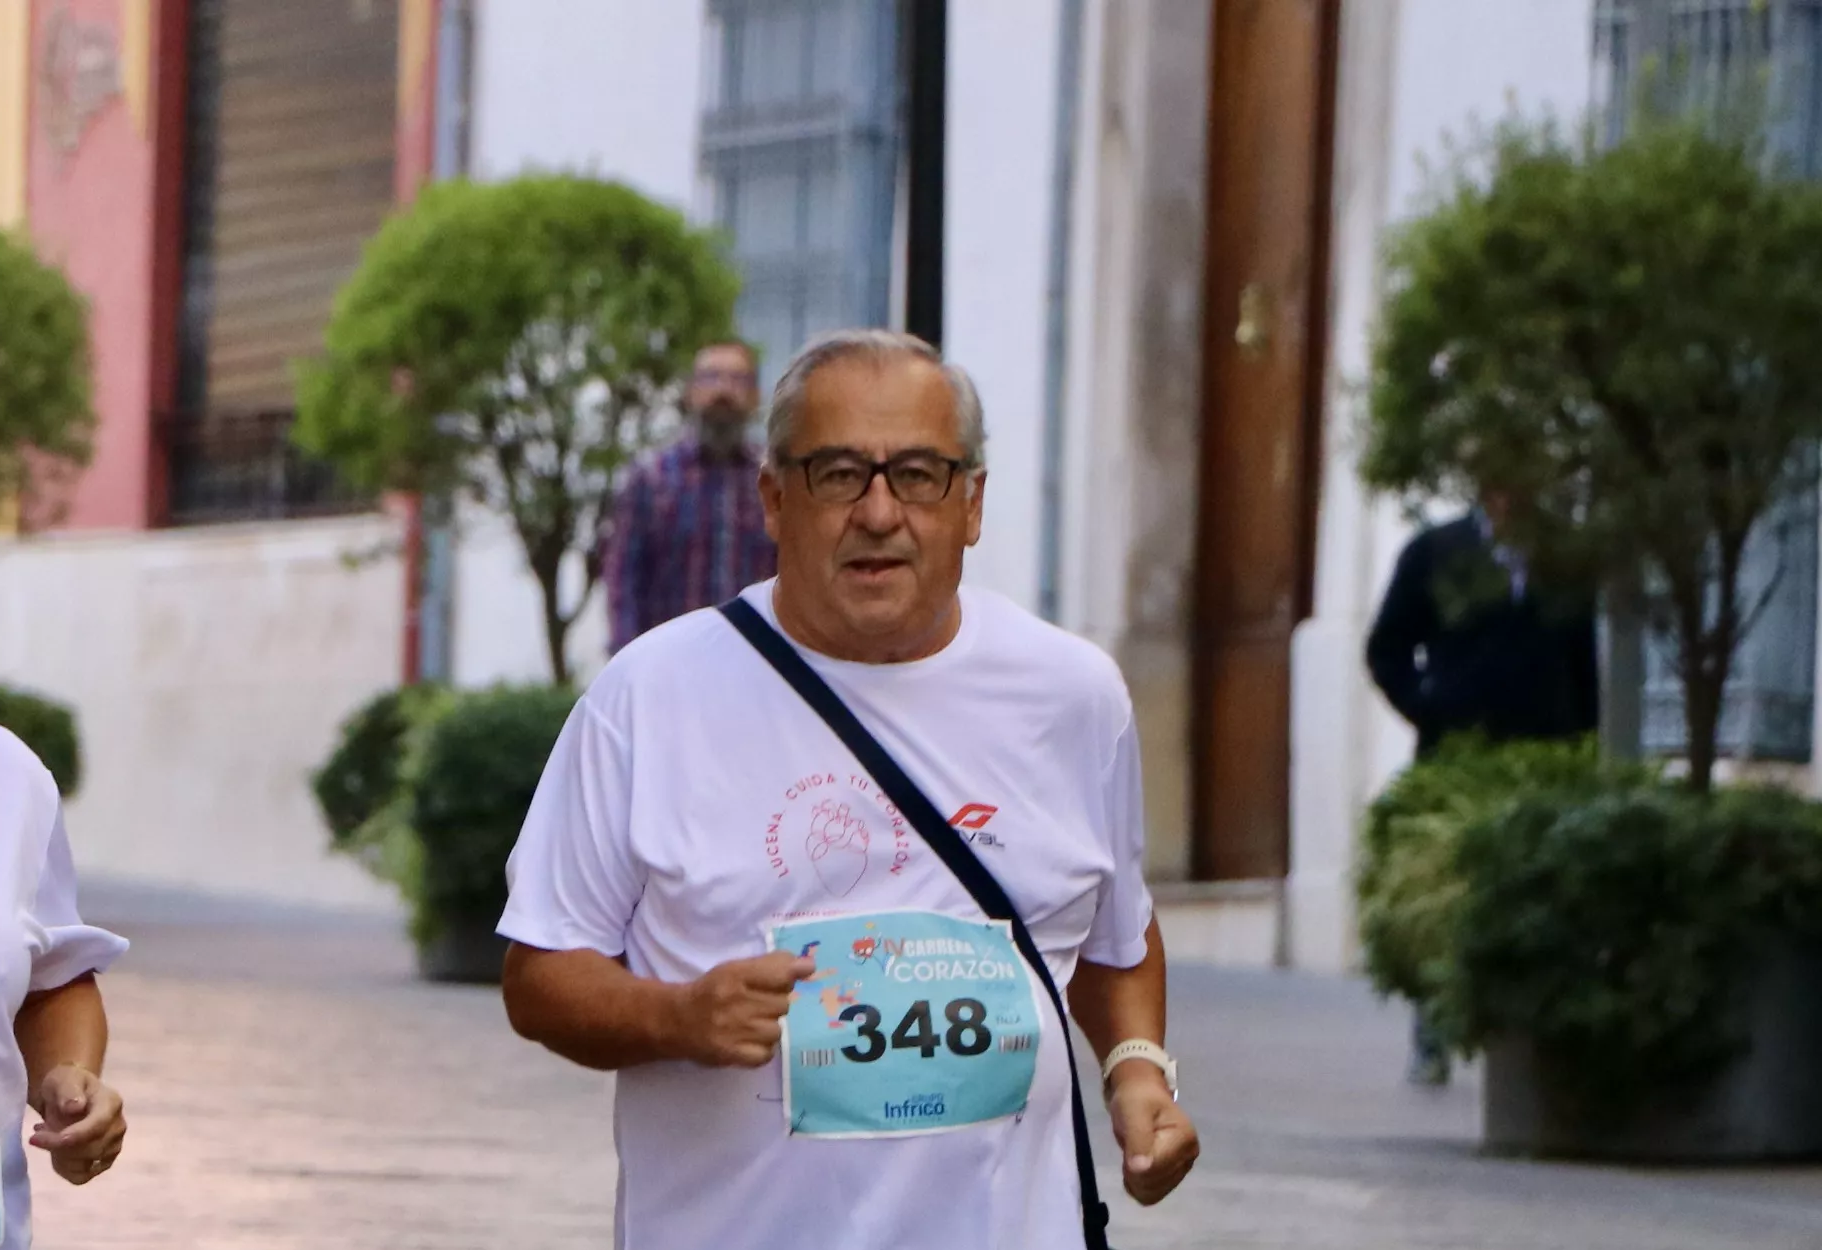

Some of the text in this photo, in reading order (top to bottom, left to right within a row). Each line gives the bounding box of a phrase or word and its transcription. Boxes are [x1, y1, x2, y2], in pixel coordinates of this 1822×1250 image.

[786, 773, 835, 800] CUIDA
[849, 774, 868, 790] TU
[838, 997, 992, 1063] 348
[884, 1099, 945, 1119] Infrico
